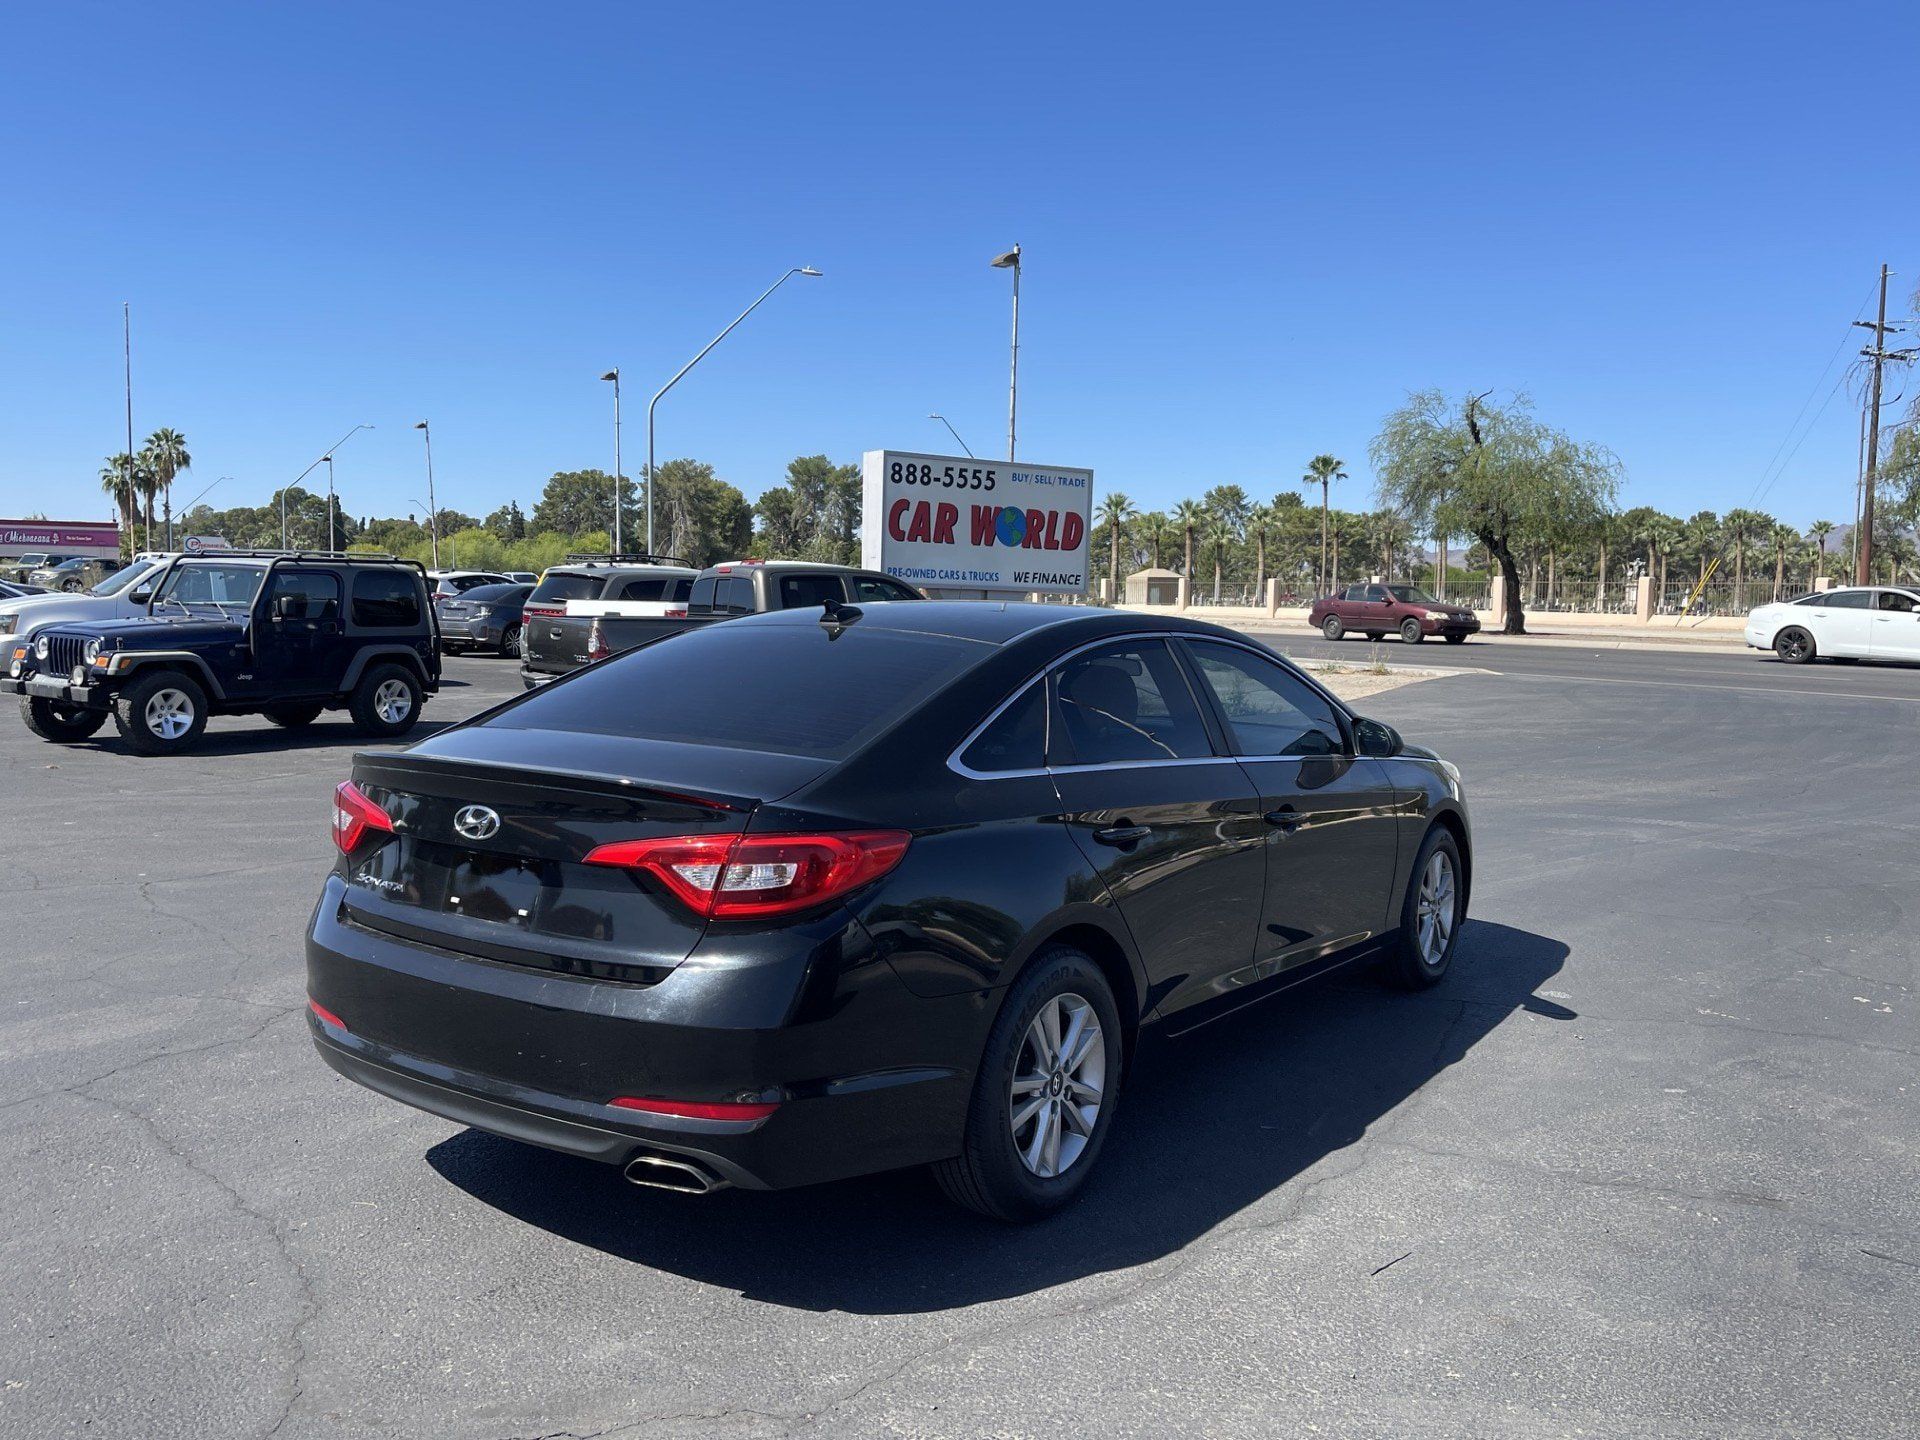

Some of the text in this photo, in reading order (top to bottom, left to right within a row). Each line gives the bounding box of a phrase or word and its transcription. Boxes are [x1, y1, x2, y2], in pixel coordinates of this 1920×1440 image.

[890, 462, 996, 491] 888-5555
[1058, 476, 1086, 488] TRADE
[888, 498, 959, 544] CAR
[888, 566, 999, 582] PRE-OWNED CARS & TRUCKS
[1014, 572, 1081, 586] WE FINANCE
